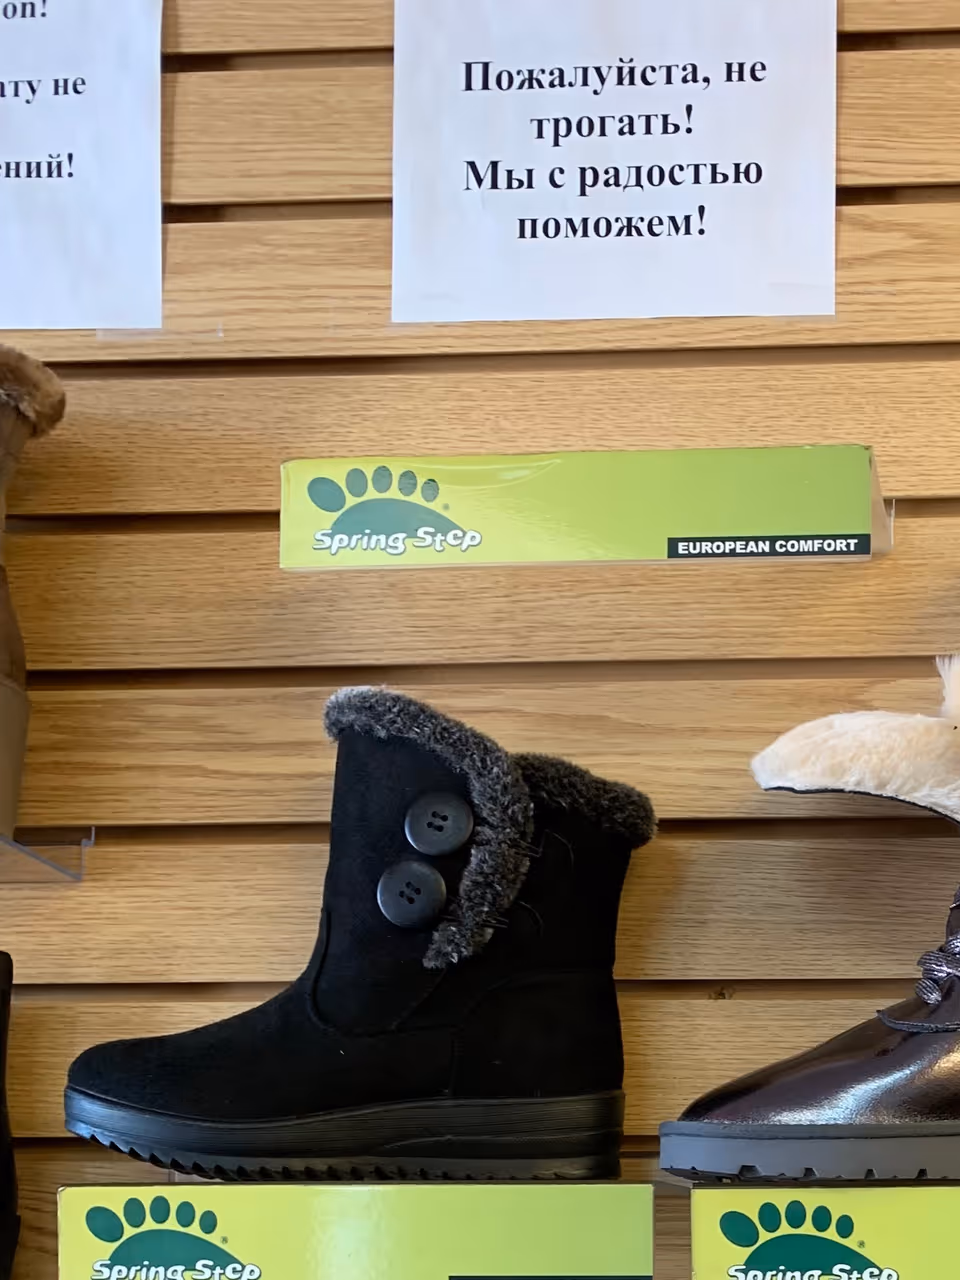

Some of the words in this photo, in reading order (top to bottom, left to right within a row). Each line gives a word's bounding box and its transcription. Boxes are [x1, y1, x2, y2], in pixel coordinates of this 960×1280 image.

[53, 76, 87, 95] не
[462, 57, 711, 95] Пожалуйста,
[724, 60, 767, 83] не
[530, 104, 693, 147] трогать!
[0, 152, 74, 179] ний!
[463, 160, 534, 191] Мы
[549, 165, 565, 188] с
[577, 160, 763, 197] радостью
[517, 204, 706, 239] поможем!
[312, 528, 407, 556] Spring
[412, 526, 482, 553] Step
[677, 540, 770, 554] EUROPEAN
[774, 539, 859, 553] COMFORT
